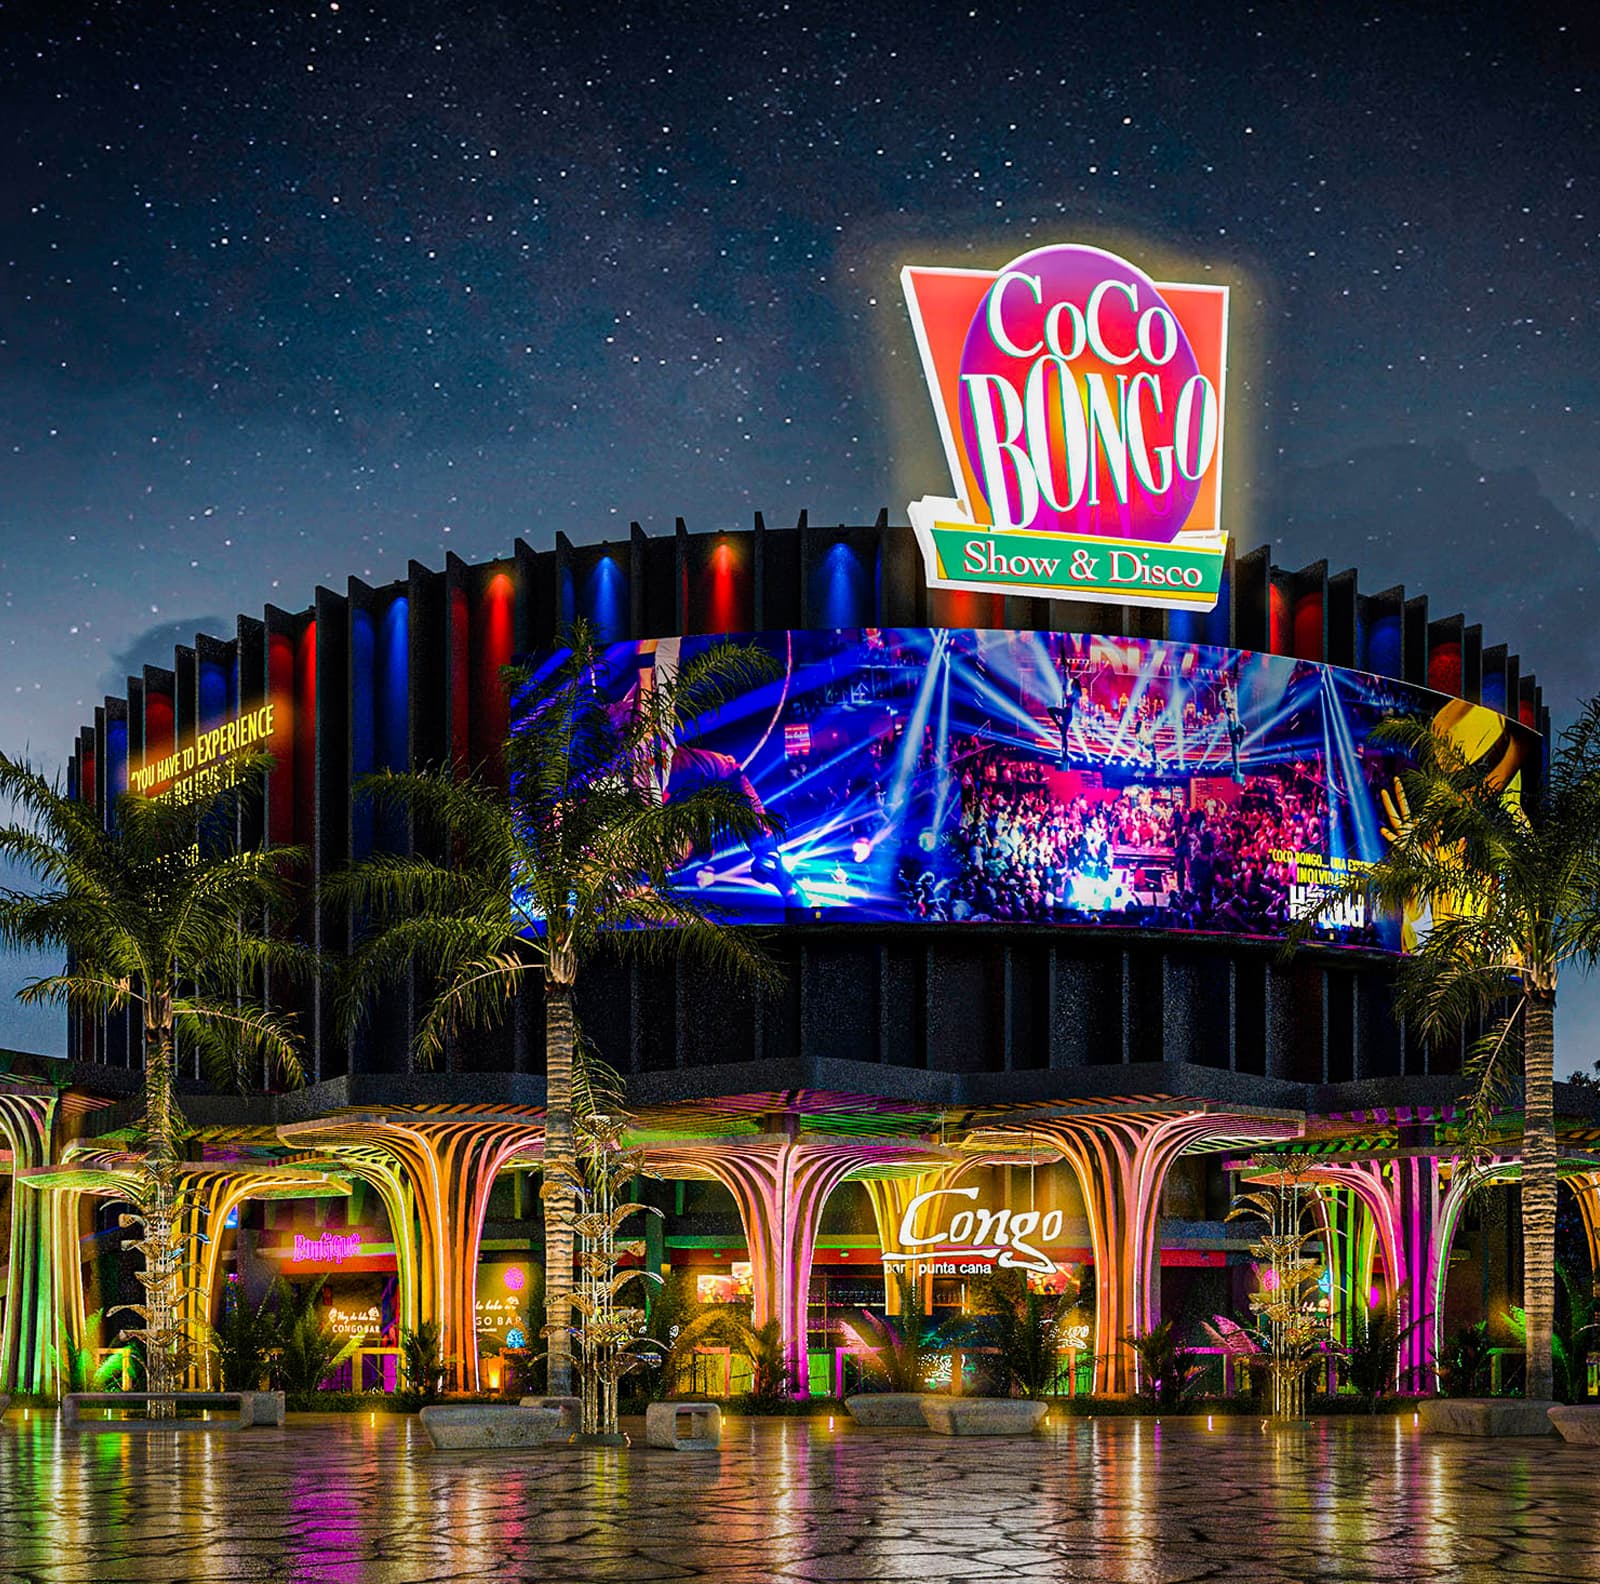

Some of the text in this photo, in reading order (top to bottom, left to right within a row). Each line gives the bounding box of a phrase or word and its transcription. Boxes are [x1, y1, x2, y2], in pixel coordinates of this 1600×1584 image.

[960, 354, 1217, 531] BONGO
[964, 541, 1203, 588] Show & Disco
[157, 753, 181, 784] HAVE
[182, 746, 195, 772] TO
[197, 704, 274, 766] EXPERIENCE
[896, 1187, 1063, 1274] Congo
[919, 1262, 956, 1277] punta
[959, 1263, 991, 1275] cana
[332, 1324, 363, 1334] CONGO
